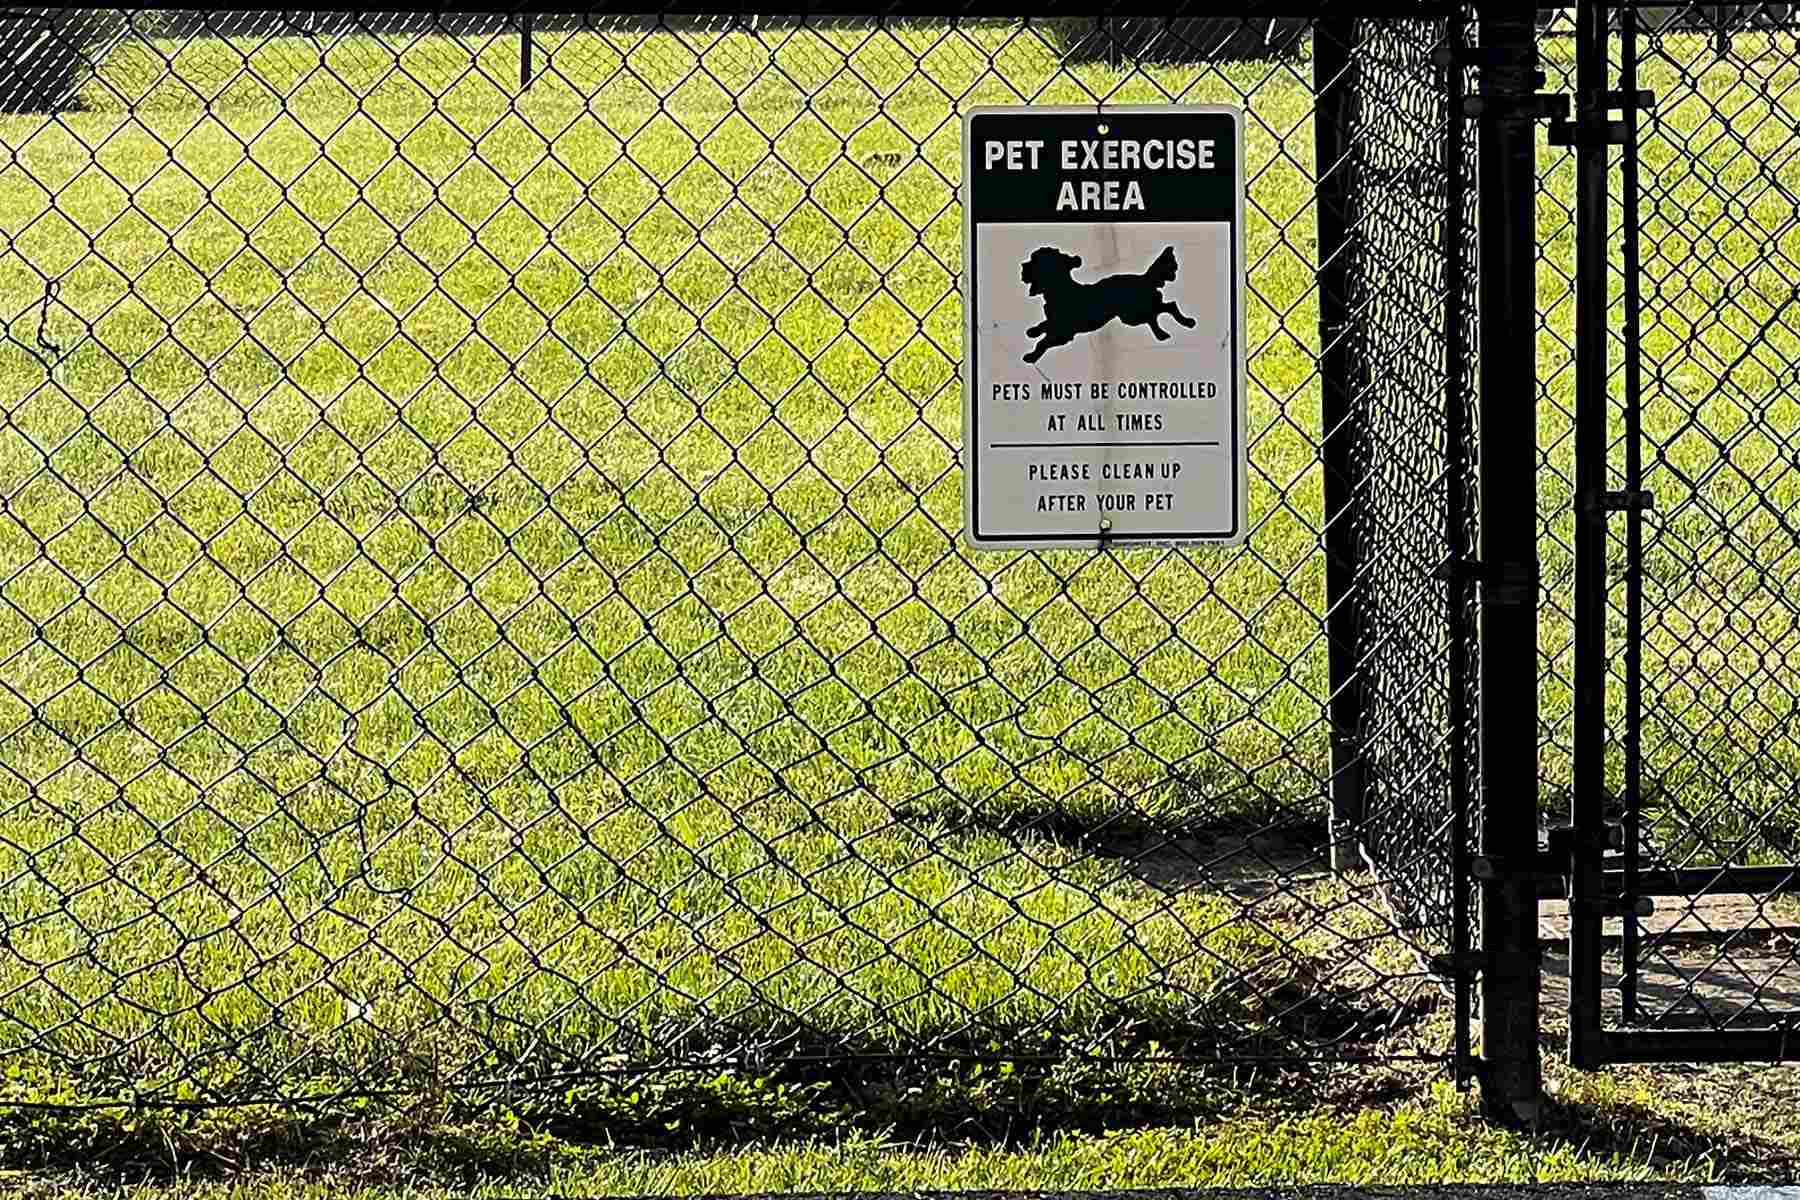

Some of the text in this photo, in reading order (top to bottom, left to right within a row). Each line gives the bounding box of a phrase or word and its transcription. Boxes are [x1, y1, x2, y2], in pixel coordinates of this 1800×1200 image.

[985, 138, 1216, 171] PET EXERCISE
[1055, 180, 1145, 211] AREA
[992, 382, 1217, 401] PETS MUST BE CONTROLLED
[1047, 414, 1163, 431] AT ALL TIMES
[1029, 463, 1182, 481] PLEASE CLEAN UP
[1037, 493, 1174, 512] AFTER YOUR PET
